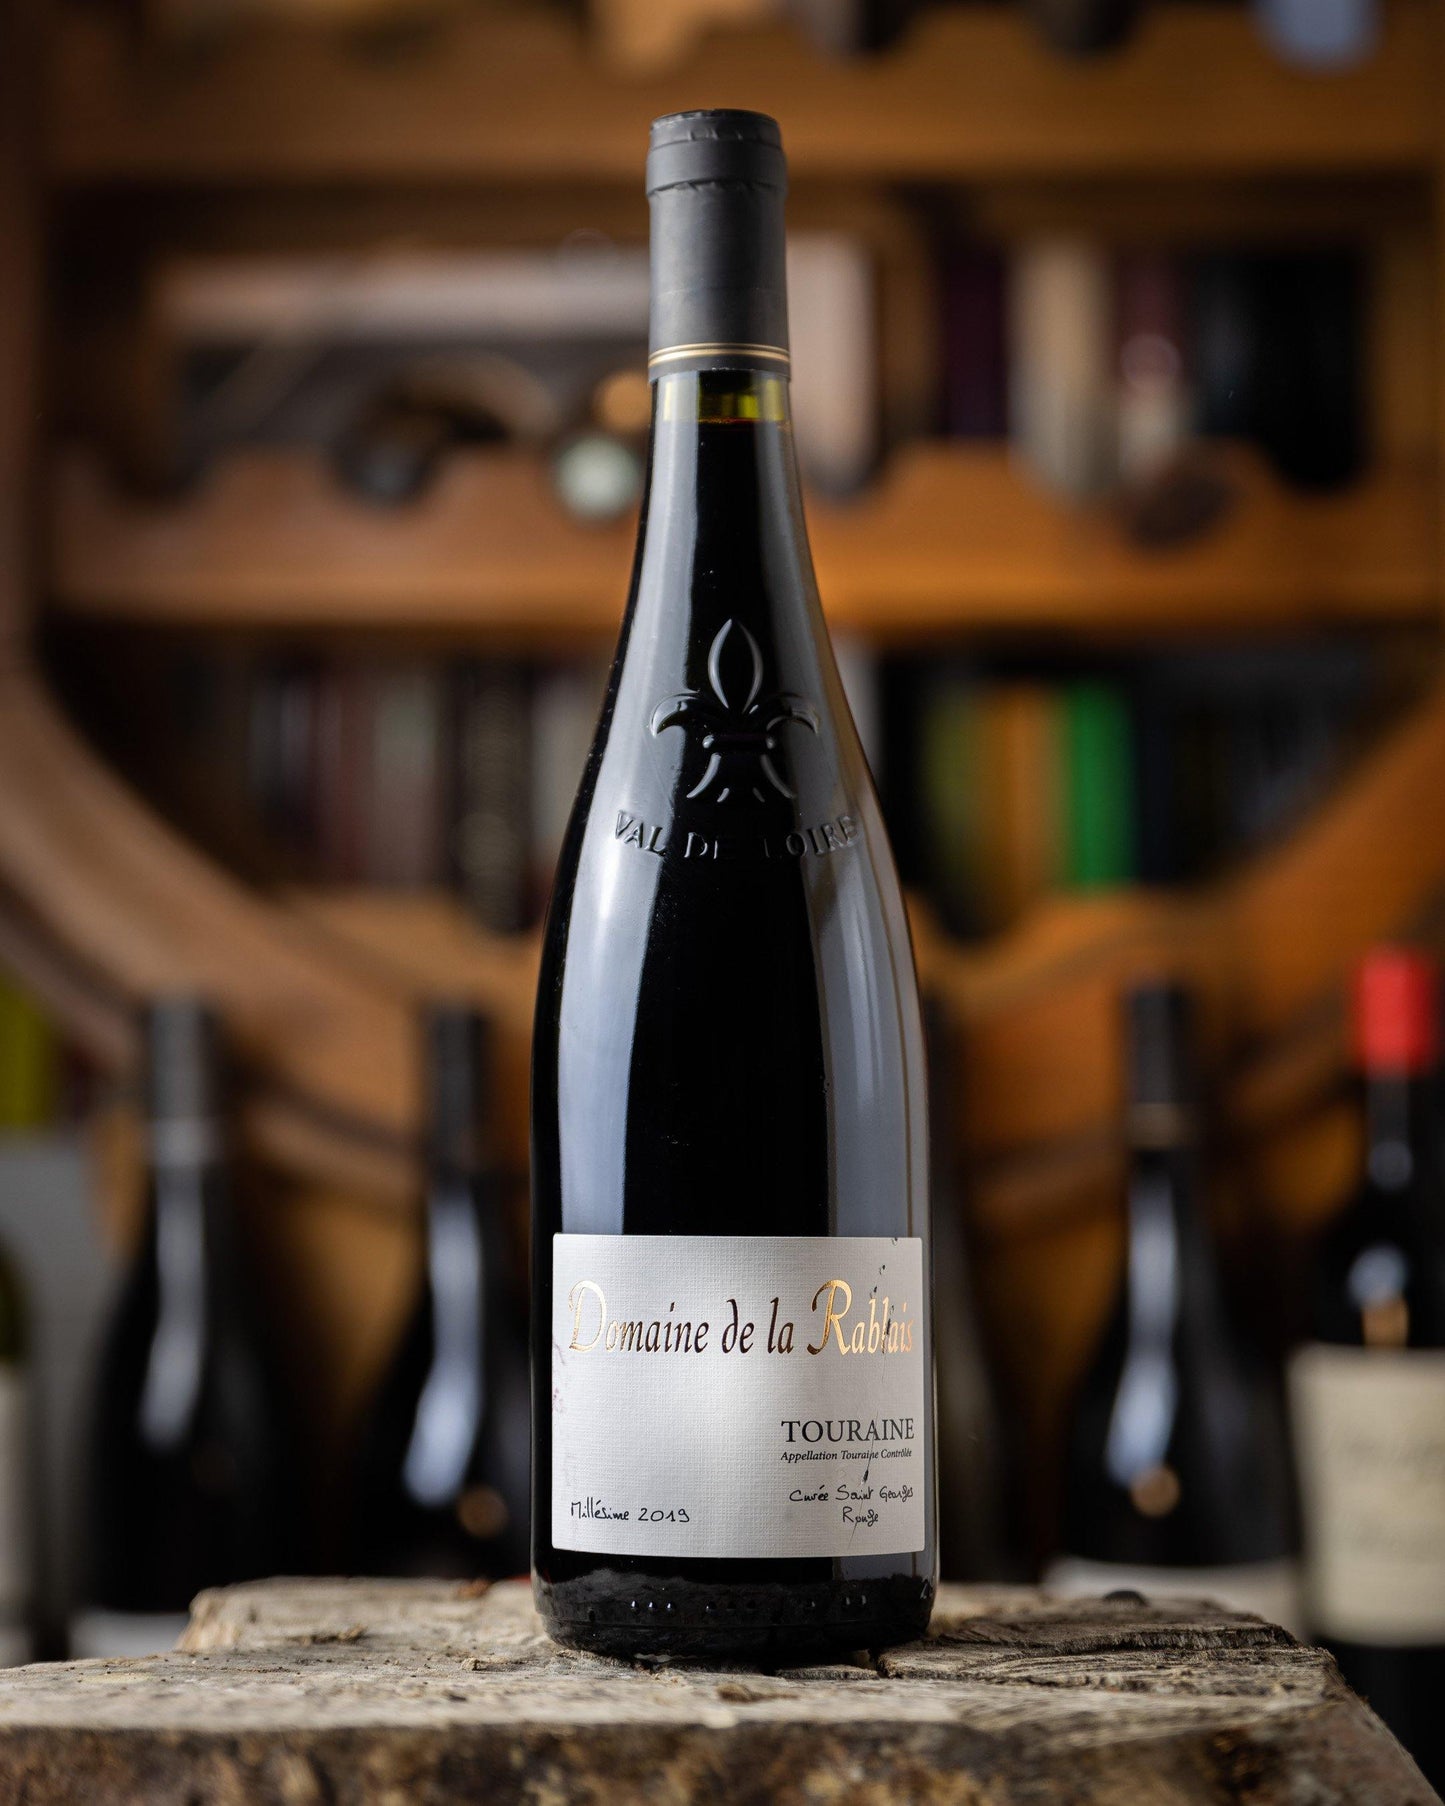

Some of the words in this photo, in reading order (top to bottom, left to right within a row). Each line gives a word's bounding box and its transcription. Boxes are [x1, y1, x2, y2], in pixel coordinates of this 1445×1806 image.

[615, 810, 667, 856] VAL
[568, 1280, 710, 1354] Domaine
[721, 1298, 754, 1354] de
[767, 1296, 794, 1354] la
[806, 1279, 914, 1355] Rablais
[780, 1418, 915, 1443] TOURAINE
[780, 1450, 838, 1463] Appellation
[841, 1450, 879, 1460] Touraine
[881, 1448, 912, 1459] Contrôlée
[789, 1485, 829, 1502] Cuvée
[835, 1485, 873, 1500] Saint
[879, 1485, 914, 1502] Georges
[571, 1497, 630, 1521] Millésime
[638, 1507, 690, 1522] 2019
[842, 1506, 879, 1527] Rouge
